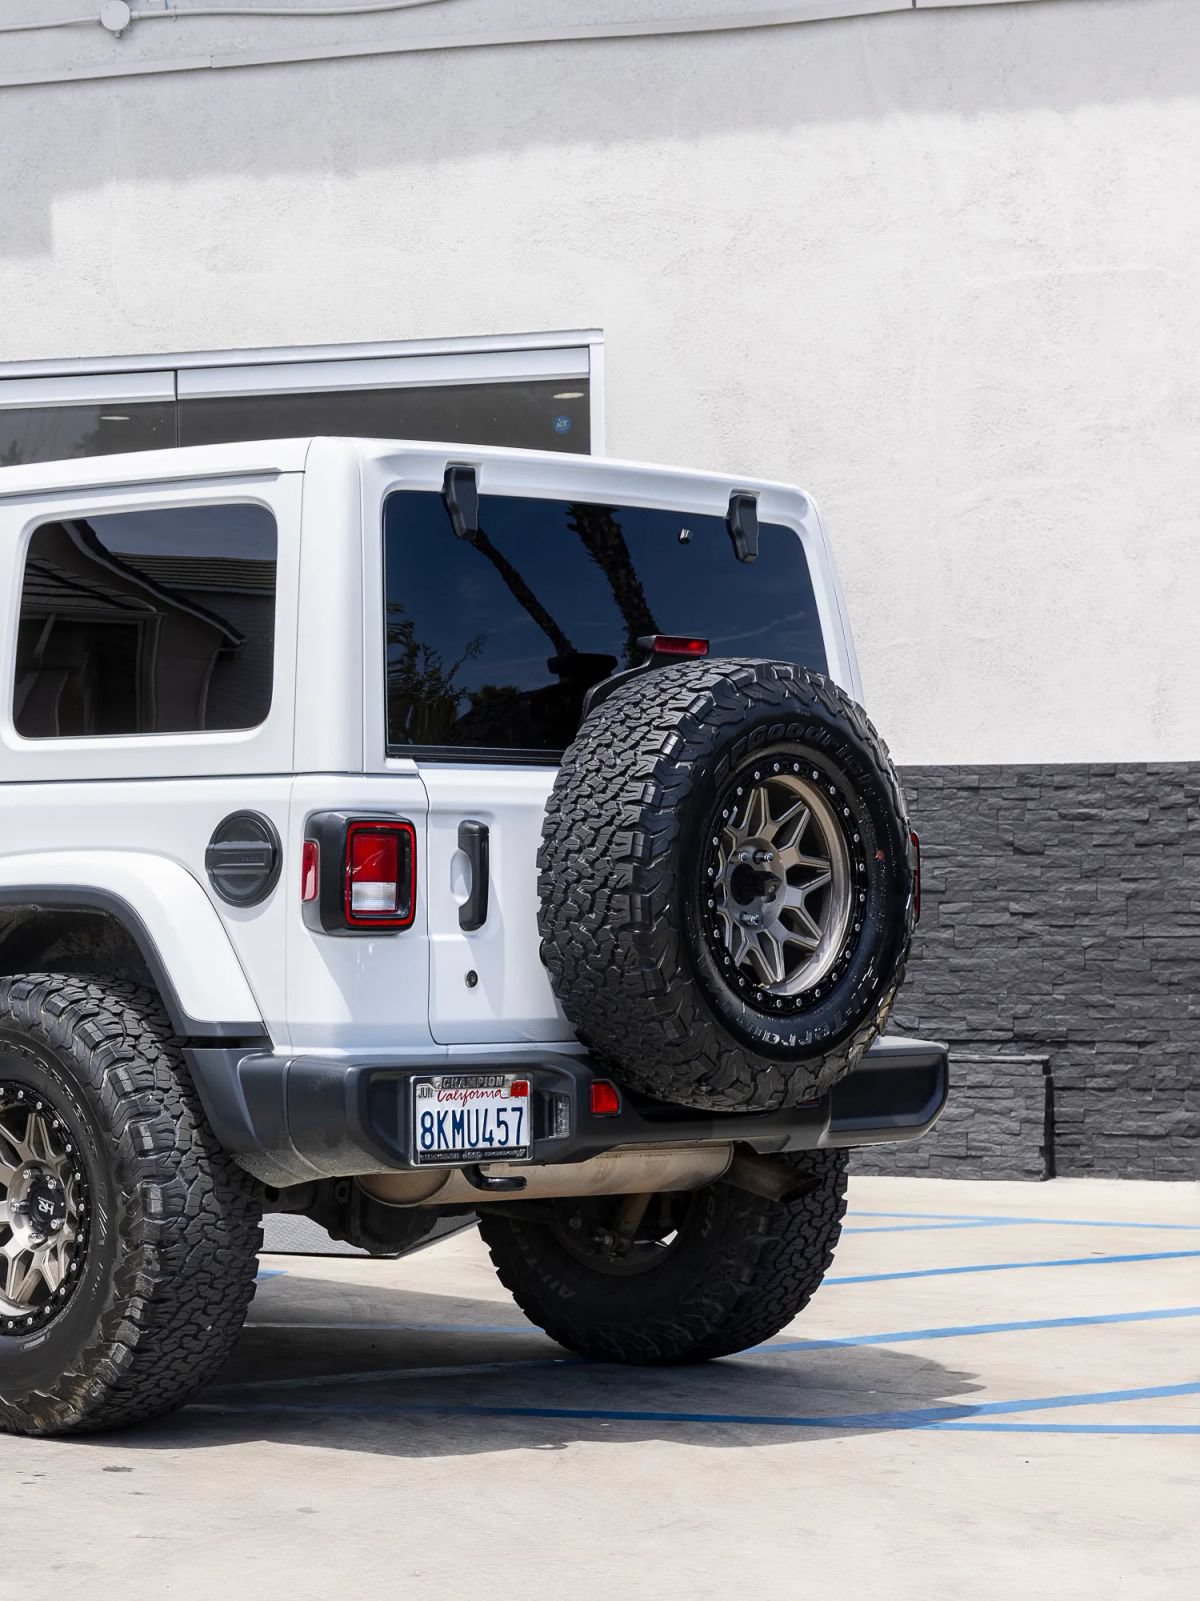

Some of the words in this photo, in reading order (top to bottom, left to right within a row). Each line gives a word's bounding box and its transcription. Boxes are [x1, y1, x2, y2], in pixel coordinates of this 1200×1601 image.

[442, 1076, 505, 1089] CHAMPION
[417, 1087, 433, 1099] JUN
[437, 1088, 510, 1107] California
[420, 1106, 524, 1150] 8KMU457
